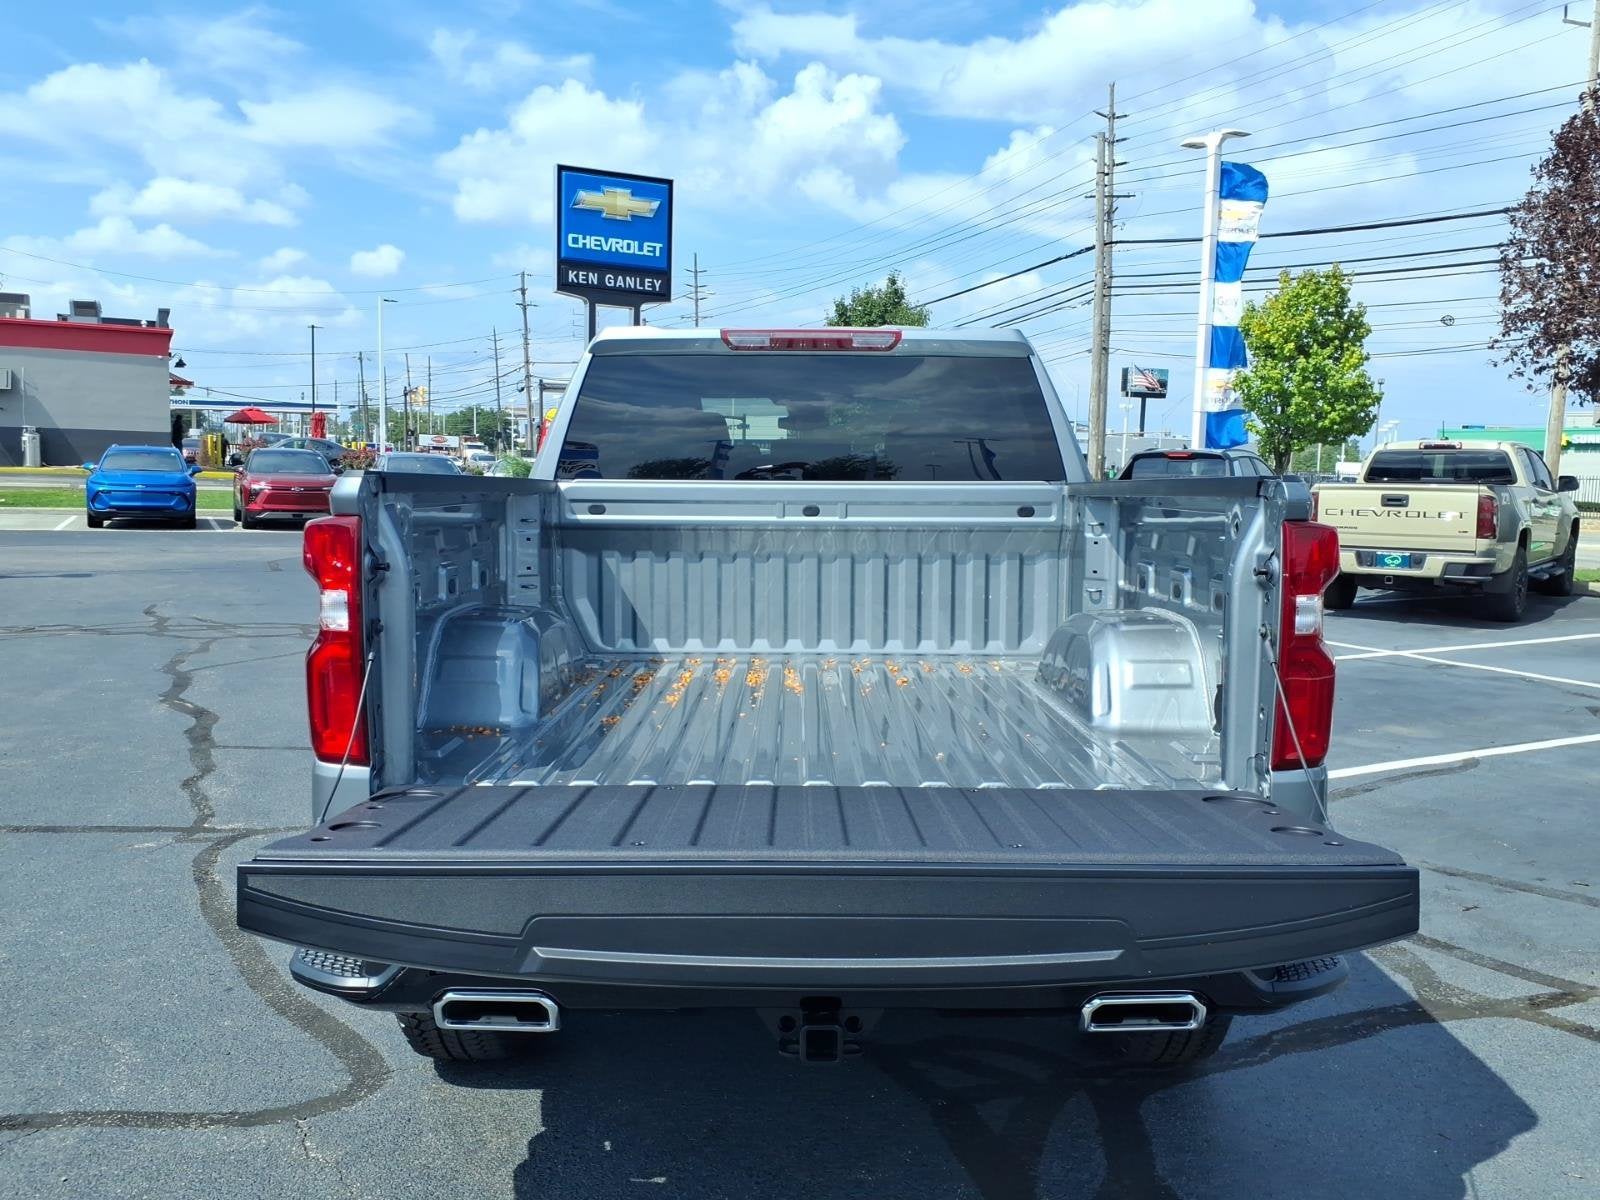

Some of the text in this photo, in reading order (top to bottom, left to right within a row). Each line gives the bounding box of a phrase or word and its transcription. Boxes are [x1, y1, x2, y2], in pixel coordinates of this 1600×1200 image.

[567, 233, 663, 257] CHEVROLET
[568, 270, 662, 292] KEN GANLEY
[1325, 508, 1469, 519] CHEVROLET
